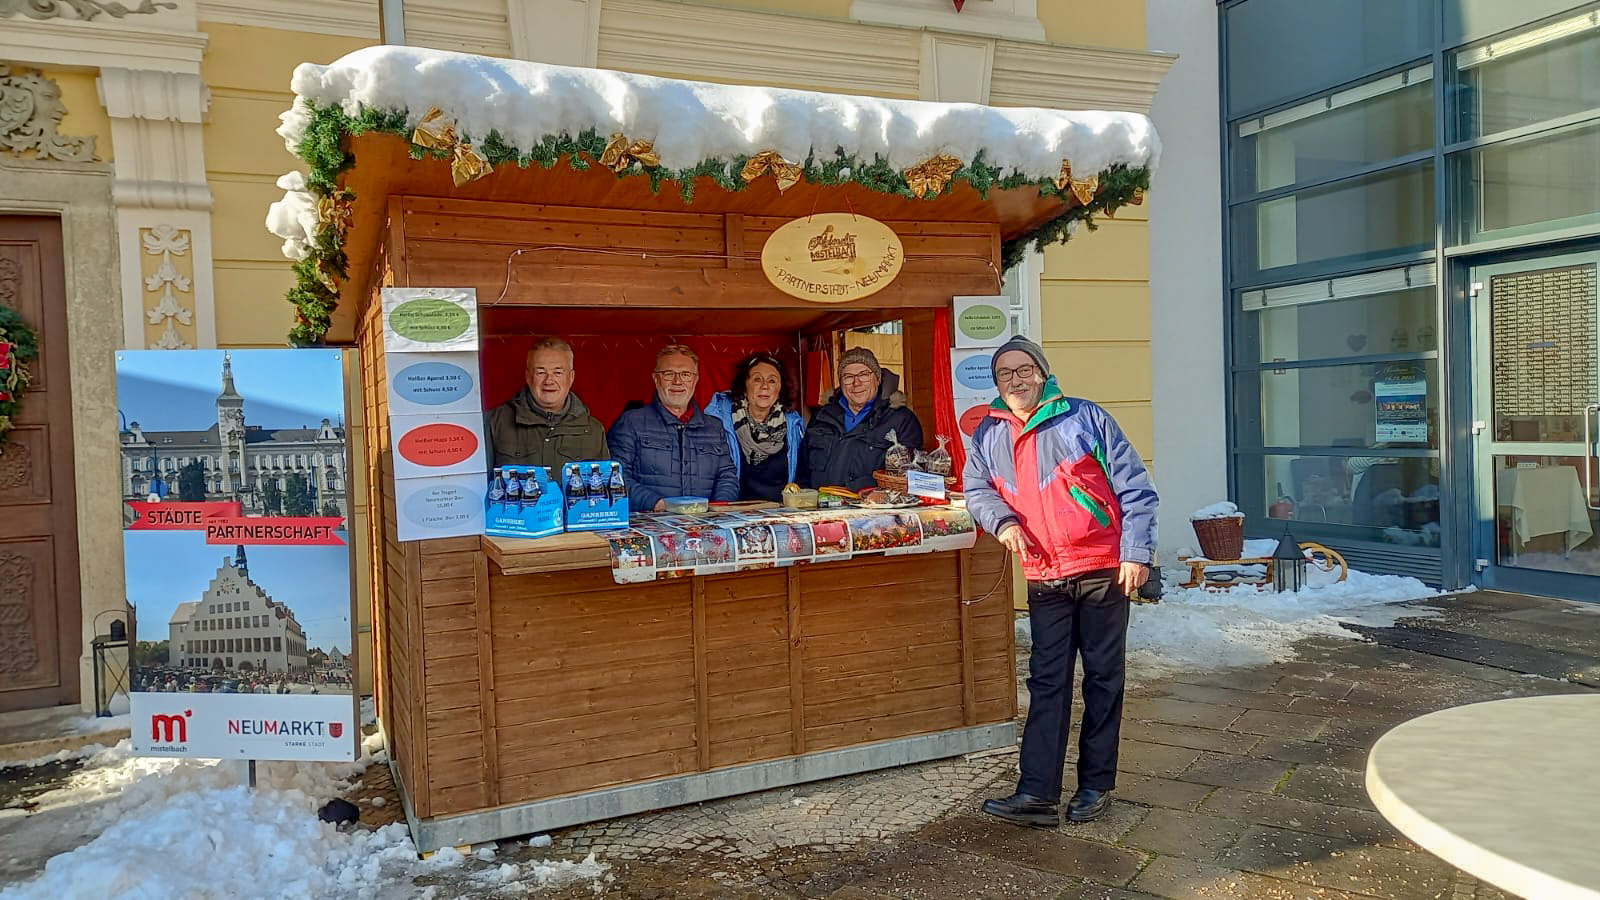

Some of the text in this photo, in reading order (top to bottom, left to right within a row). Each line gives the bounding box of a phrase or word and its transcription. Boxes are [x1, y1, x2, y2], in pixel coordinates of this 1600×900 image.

[148, 508, 201, 525] STÄDTE
[207, 525, 331, 539] PARTNERSCHAFT
[228, 719, 325, 736] NEUMARKT
